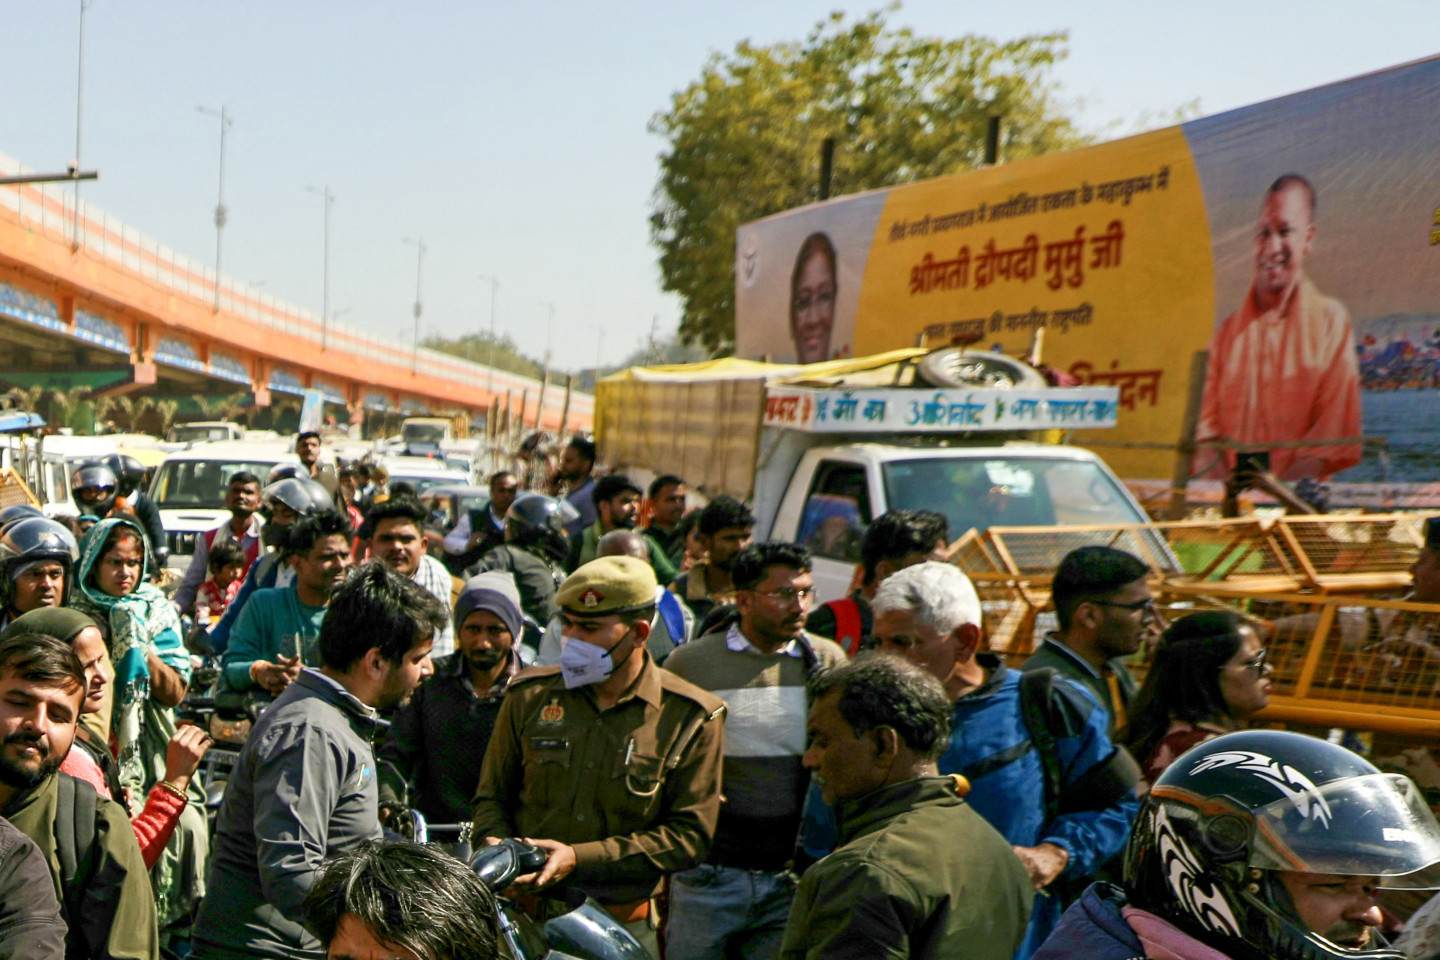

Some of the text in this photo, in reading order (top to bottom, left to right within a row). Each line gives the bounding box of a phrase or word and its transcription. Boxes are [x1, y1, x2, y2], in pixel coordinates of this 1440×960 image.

[1156, 165, 1170, 190] में
[910, 219, 1126, 295] श्रीमती द्रौपदी मुर्मु जी
